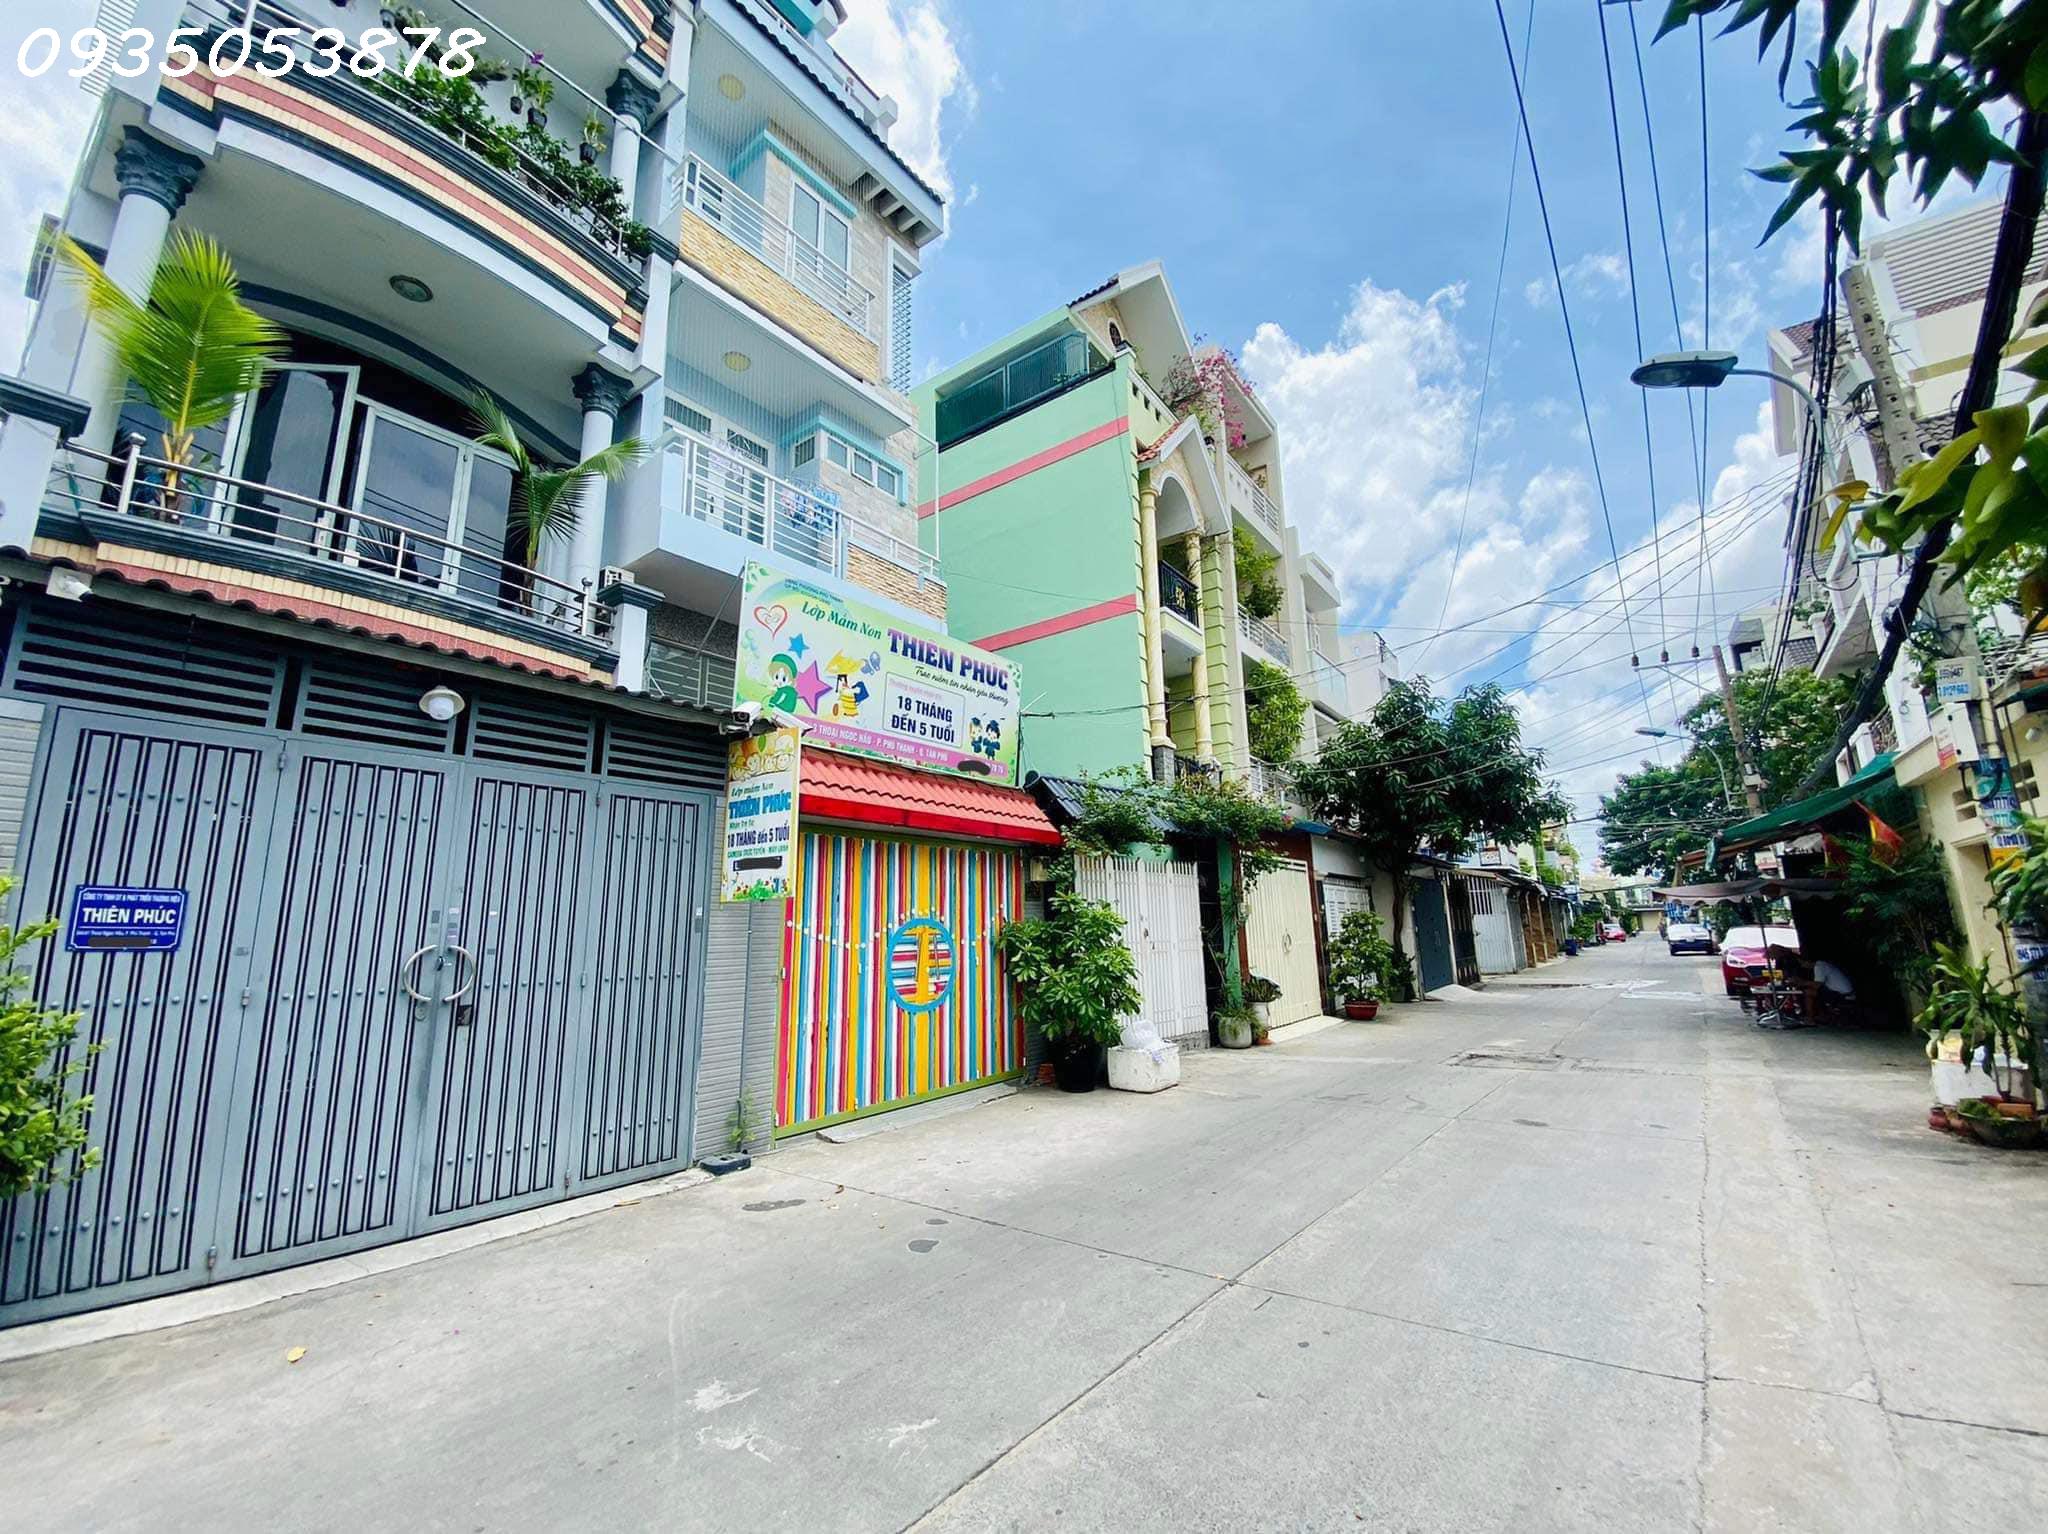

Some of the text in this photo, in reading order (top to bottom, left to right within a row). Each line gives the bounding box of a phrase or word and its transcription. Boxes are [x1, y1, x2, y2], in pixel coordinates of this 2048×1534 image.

[802, 601, 826, 621] Lớp
[859, 621, 882, 640] Non
[887, 628, 1009, 691] THIÊN PHÚC
[897, 695, 953, 723] 18 THÁNG
[891, 712, 955, 743] ĐẾN 5 TUỔI
[762, 789, 791, 814] PHÚC
[728, 833, 735, 848] 18
[736, 829, 756, 846] THÁNG
[769, 827, 774, 842] 5
[82, 905, 177, 924] THIÊN PHÚC
